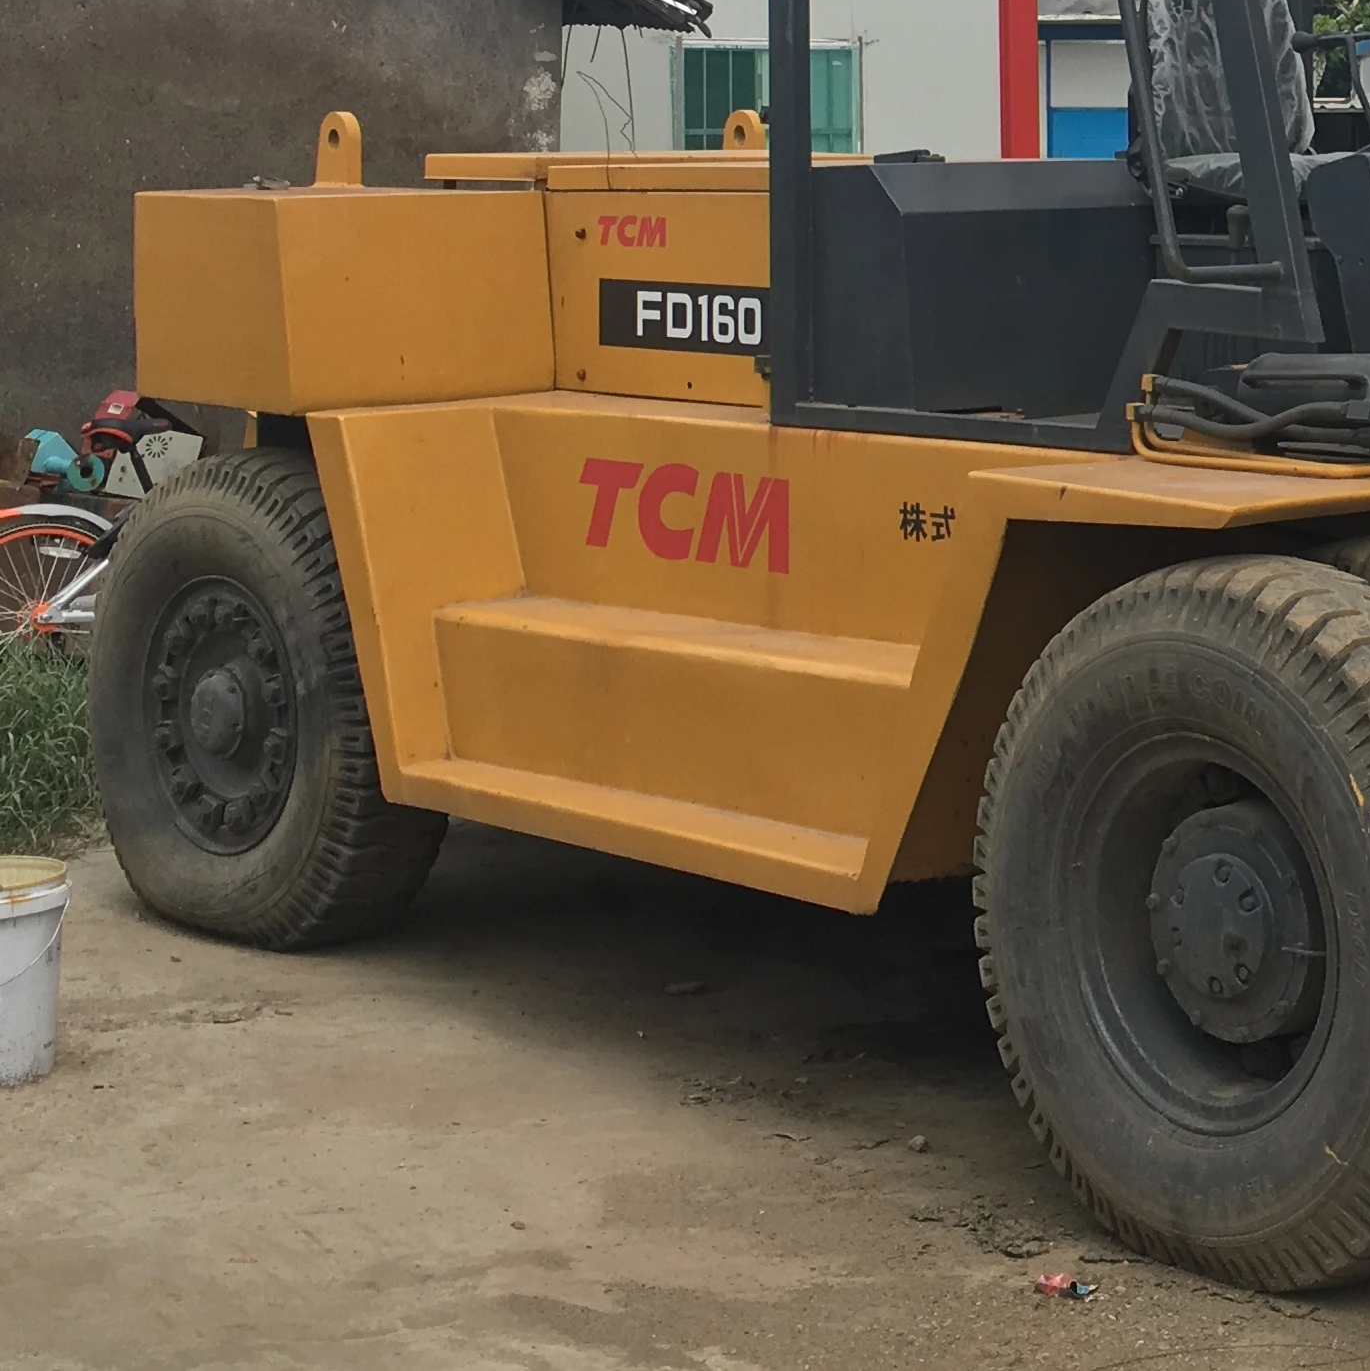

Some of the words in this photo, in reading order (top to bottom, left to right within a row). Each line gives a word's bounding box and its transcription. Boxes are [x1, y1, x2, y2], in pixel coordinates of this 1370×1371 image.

[596, 214, 668, 248] TCM
[635, 290, 762, 346] FD160
[578, 457, 791, 576] TCM
[898, 501, 956, 543] 株式
